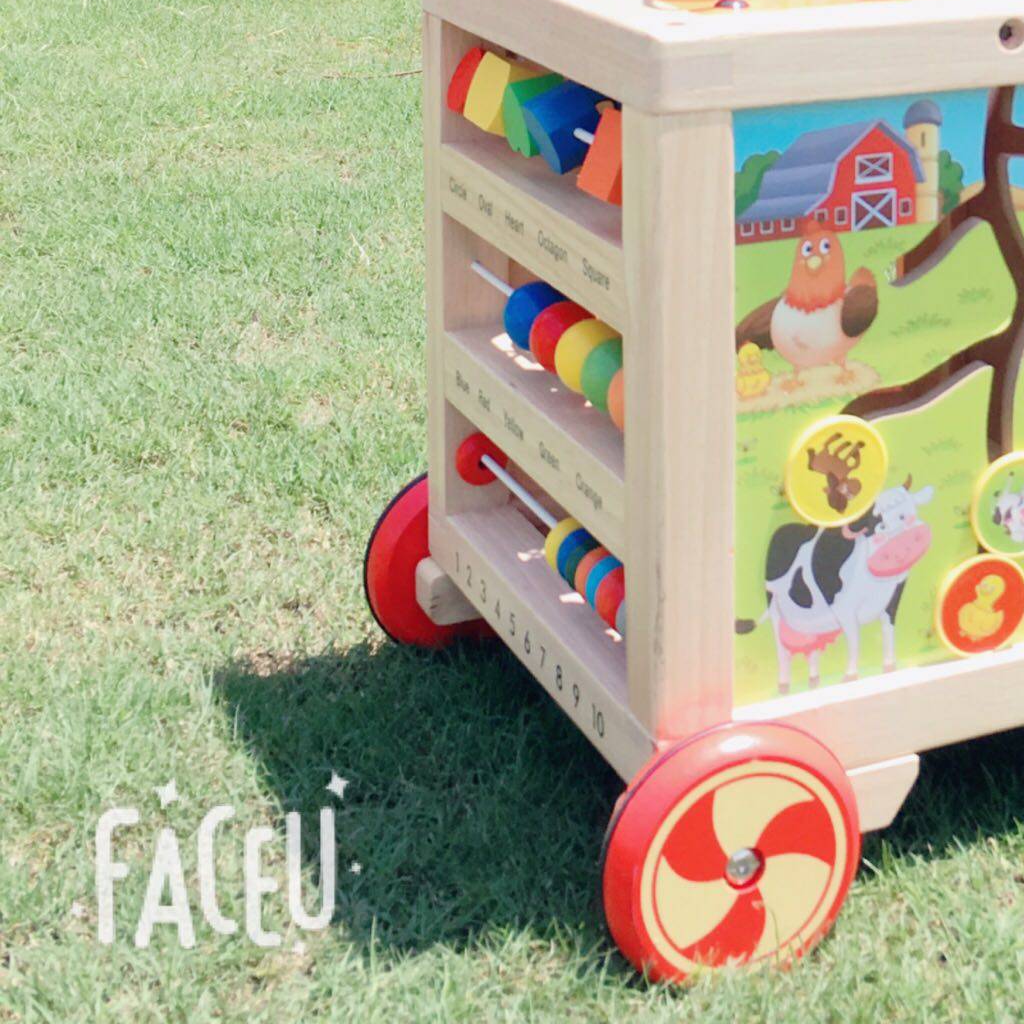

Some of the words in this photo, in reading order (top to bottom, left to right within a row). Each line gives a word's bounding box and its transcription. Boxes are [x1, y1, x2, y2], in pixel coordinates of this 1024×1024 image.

[478, 194, 494, 217] Oval
[504, 212, 525, 235] Heart
[537, 229, 569, 263] Octagon
[582, 257, 611, 291] Square
[538, 441, 560, 471] Green
[575, 472, 603, 510] Orange
[466, 565, 473, 587] 2
[480, 579, 487, 603] 3
[494, 599, 501, 620] 4
[509, 613, 516, 636] 5
[523, 631, 531, 655] 6
[539, 646, 546, 667] 7
[555, 664, 563, 691] 8
[573, 684, 580, 708] 9
[591, 703, 605, 738] 10
